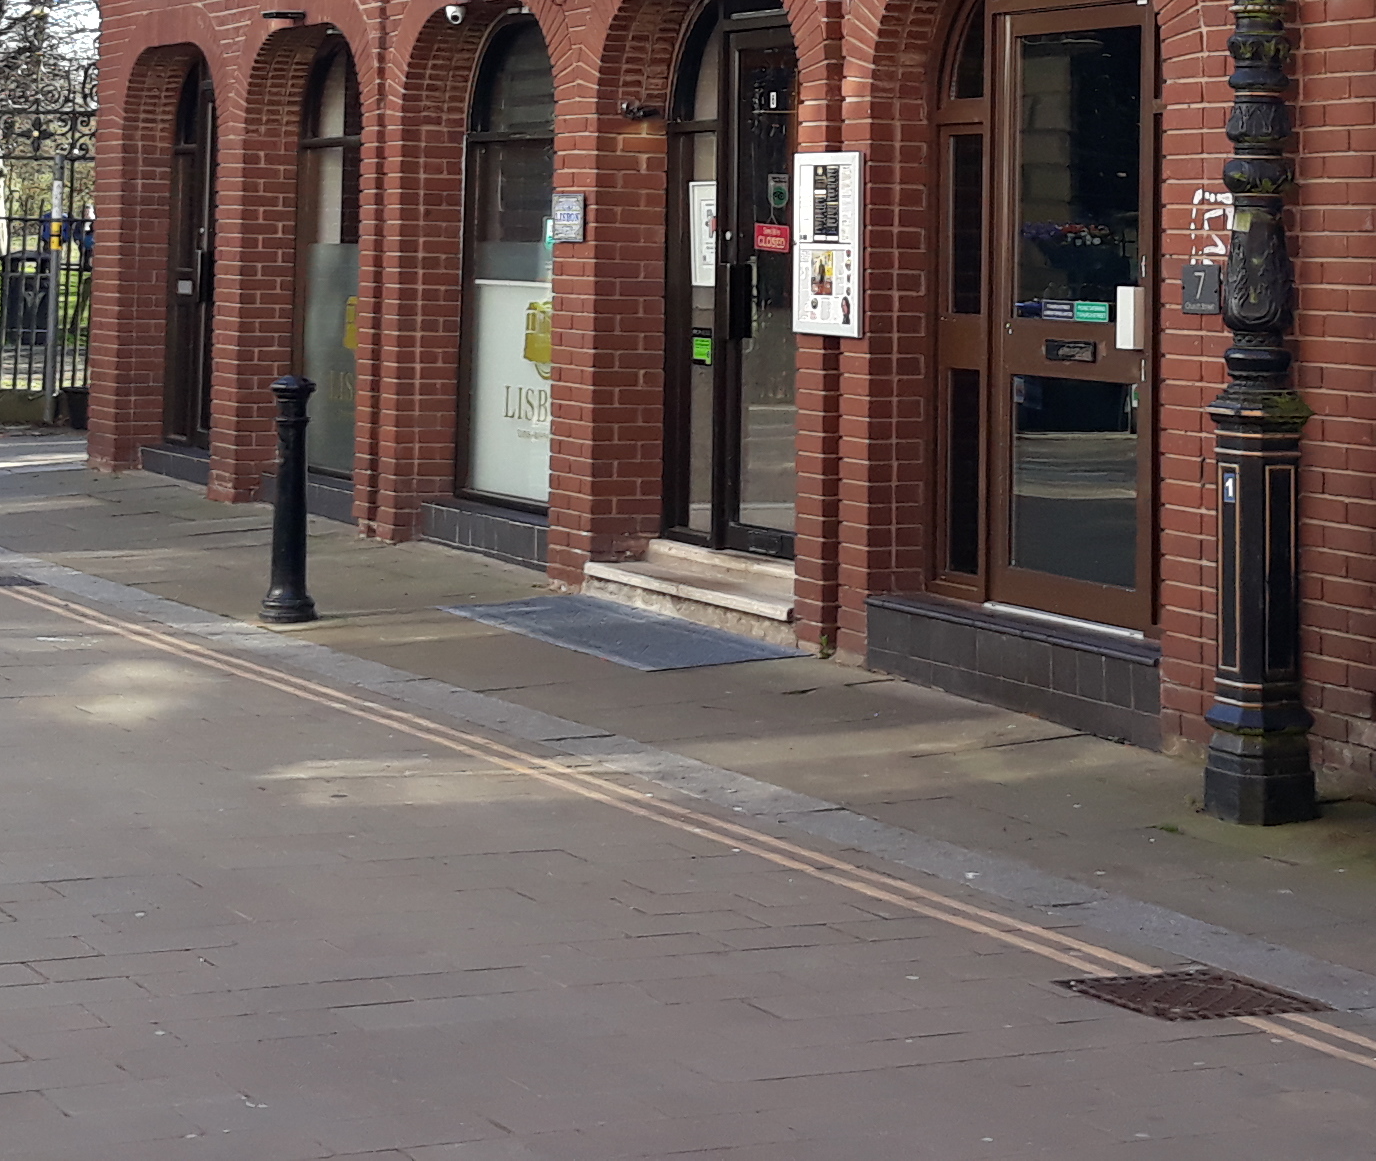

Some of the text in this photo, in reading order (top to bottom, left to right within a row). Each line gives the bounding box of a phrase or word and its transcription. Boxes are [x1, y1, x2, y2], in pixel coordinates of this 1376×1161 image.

[757, 235, 786, 248] CLOSED
[1194, 271, 1205, 300] 7
[504, 385, 548, 422] LISB
[1225, 477, 1234, 497] 1
